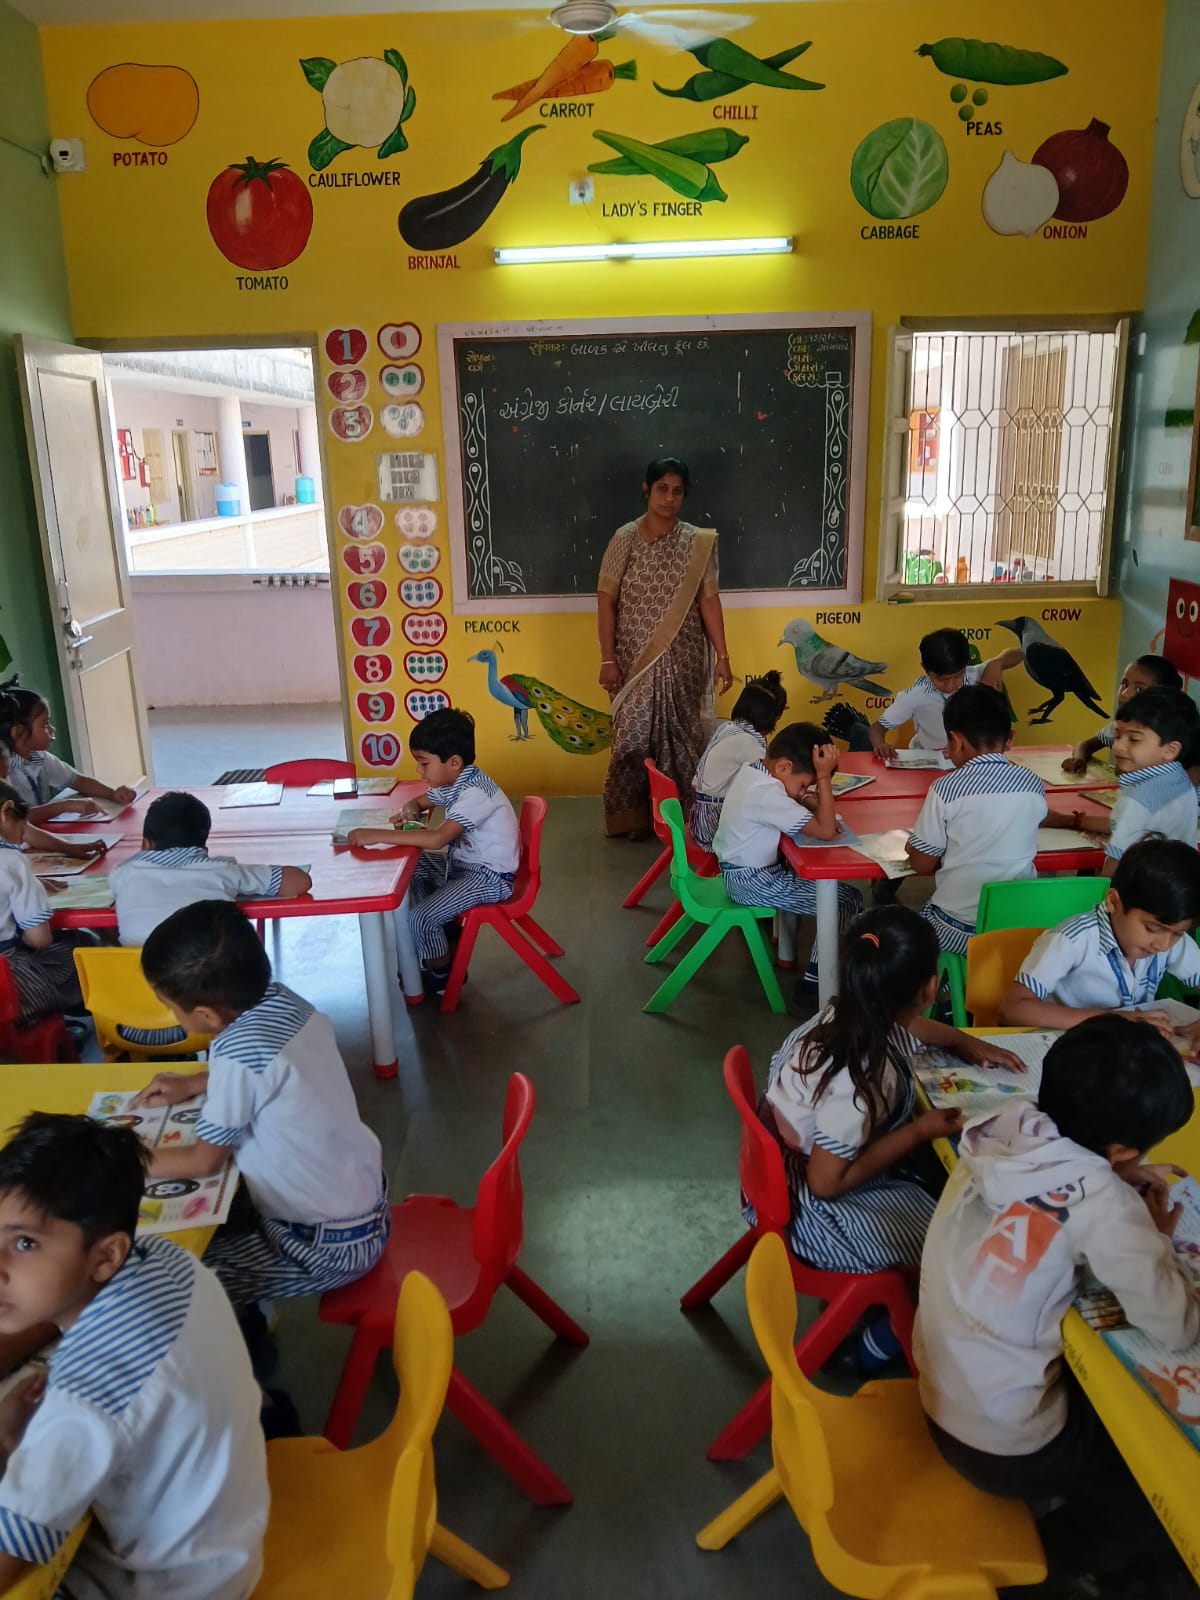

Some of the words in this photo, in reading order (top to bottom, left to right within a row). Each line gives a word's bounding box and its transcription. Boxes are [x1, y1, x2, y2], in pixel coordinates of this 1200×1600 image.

[539, 104, 594, 118] CARROT
[712, 105, 758, 120] CHILLI
[966, 121, 1003, 136] PEAS
[113, 152, 168, 167] POTATO
[308, 172, 401, 188] CAULIFLOWER
[602, 202, 648, 217] LADY'S
[653, 201, 703, 217] FINGER
[860, 225, 920, 240] CABBAGE
[1043, 225, 1088, 240] ONION
[408, 256, 461, 270] BRINJAL
[235, 276, 289, 291] TOMATO
[338, 332, 353, 361] 1
[340, 373, 358, 400] 2
[344, 410, 361, 437] 3
[351, 508, 369, 537] 4
[358, 551, 376, 574] 5
[359, 583, 376, 608] 6
[816, 611, 861, 625] PIGEON
[1041, 608, 1082, 621] CROW
[363, 619, 380, 646] 7
[464, 620, 520, 633] PEACOCK
[959, 627, 992, 641] RROT
[365, 656, 384, 681] 8
[368, 695, 386, 720] 9
[865, 697, 895, 709] CUC
[365, 735, 398, 763] 10
